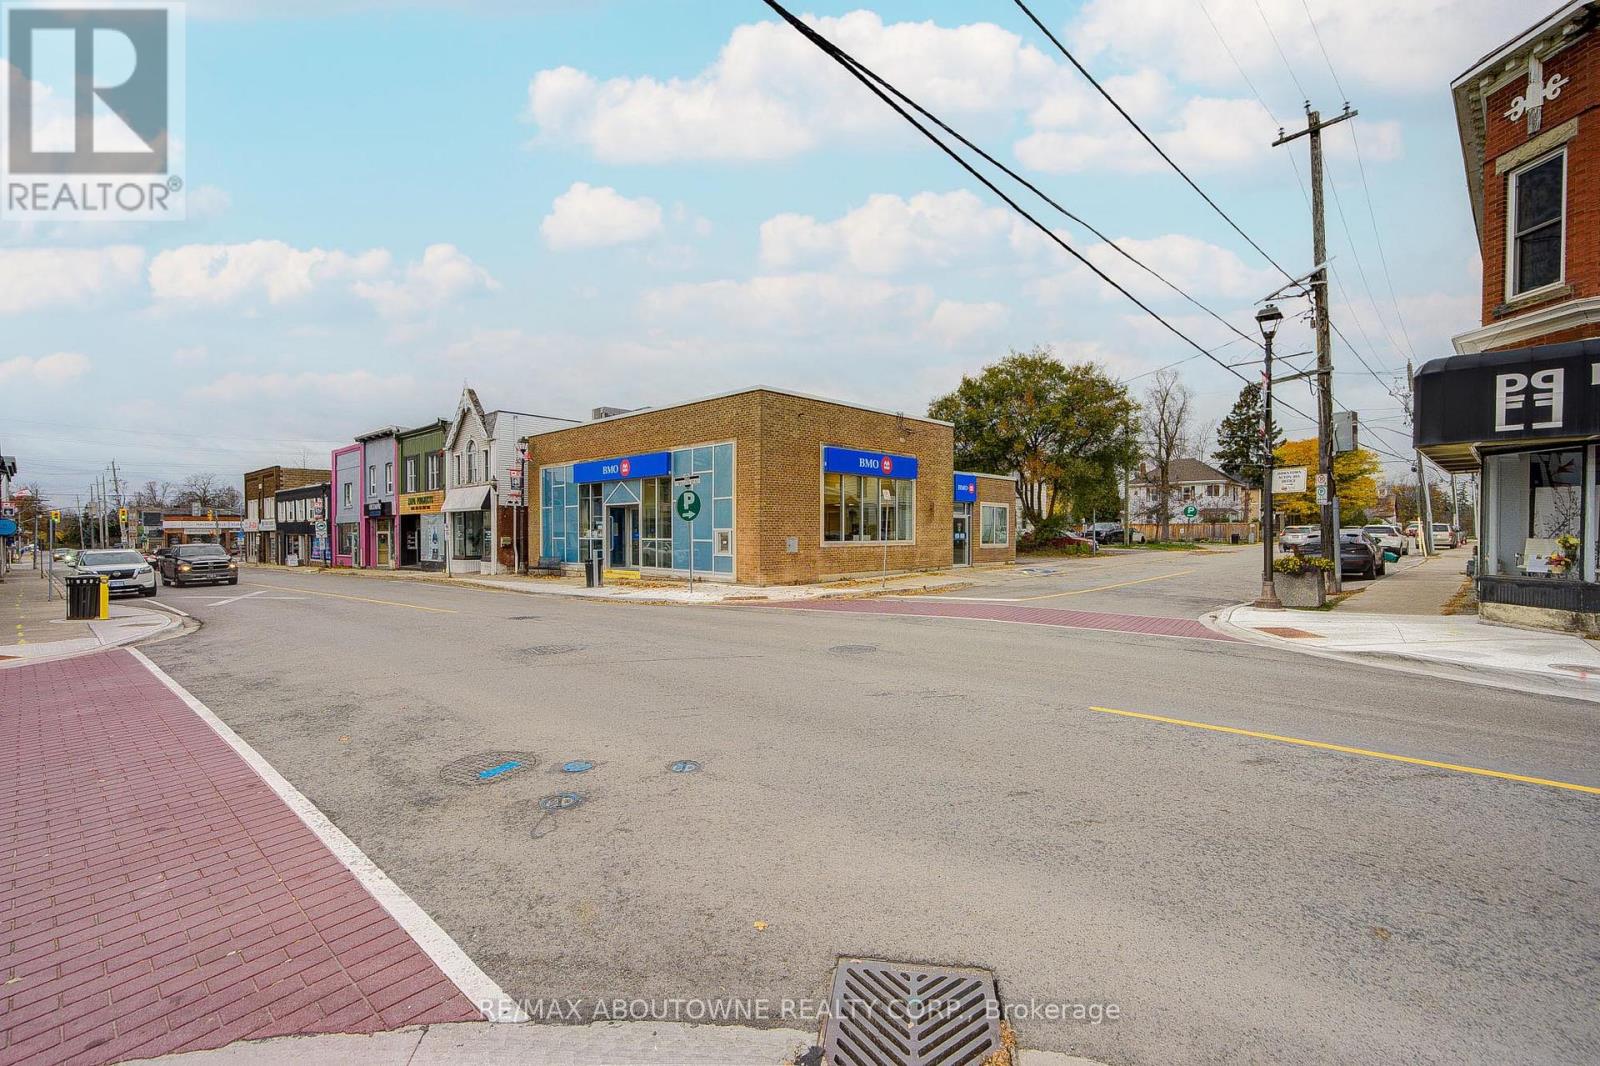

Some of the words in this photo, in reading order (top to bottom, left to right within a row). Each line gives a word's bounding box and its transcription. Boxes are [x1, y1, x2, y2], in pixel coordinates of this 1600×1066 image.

[859, 458, 879, 469] BMO
[602, 465, 619, 475] BMO
[683, 492, 695, 510] P
[1187, 506, 1195, 514] P
